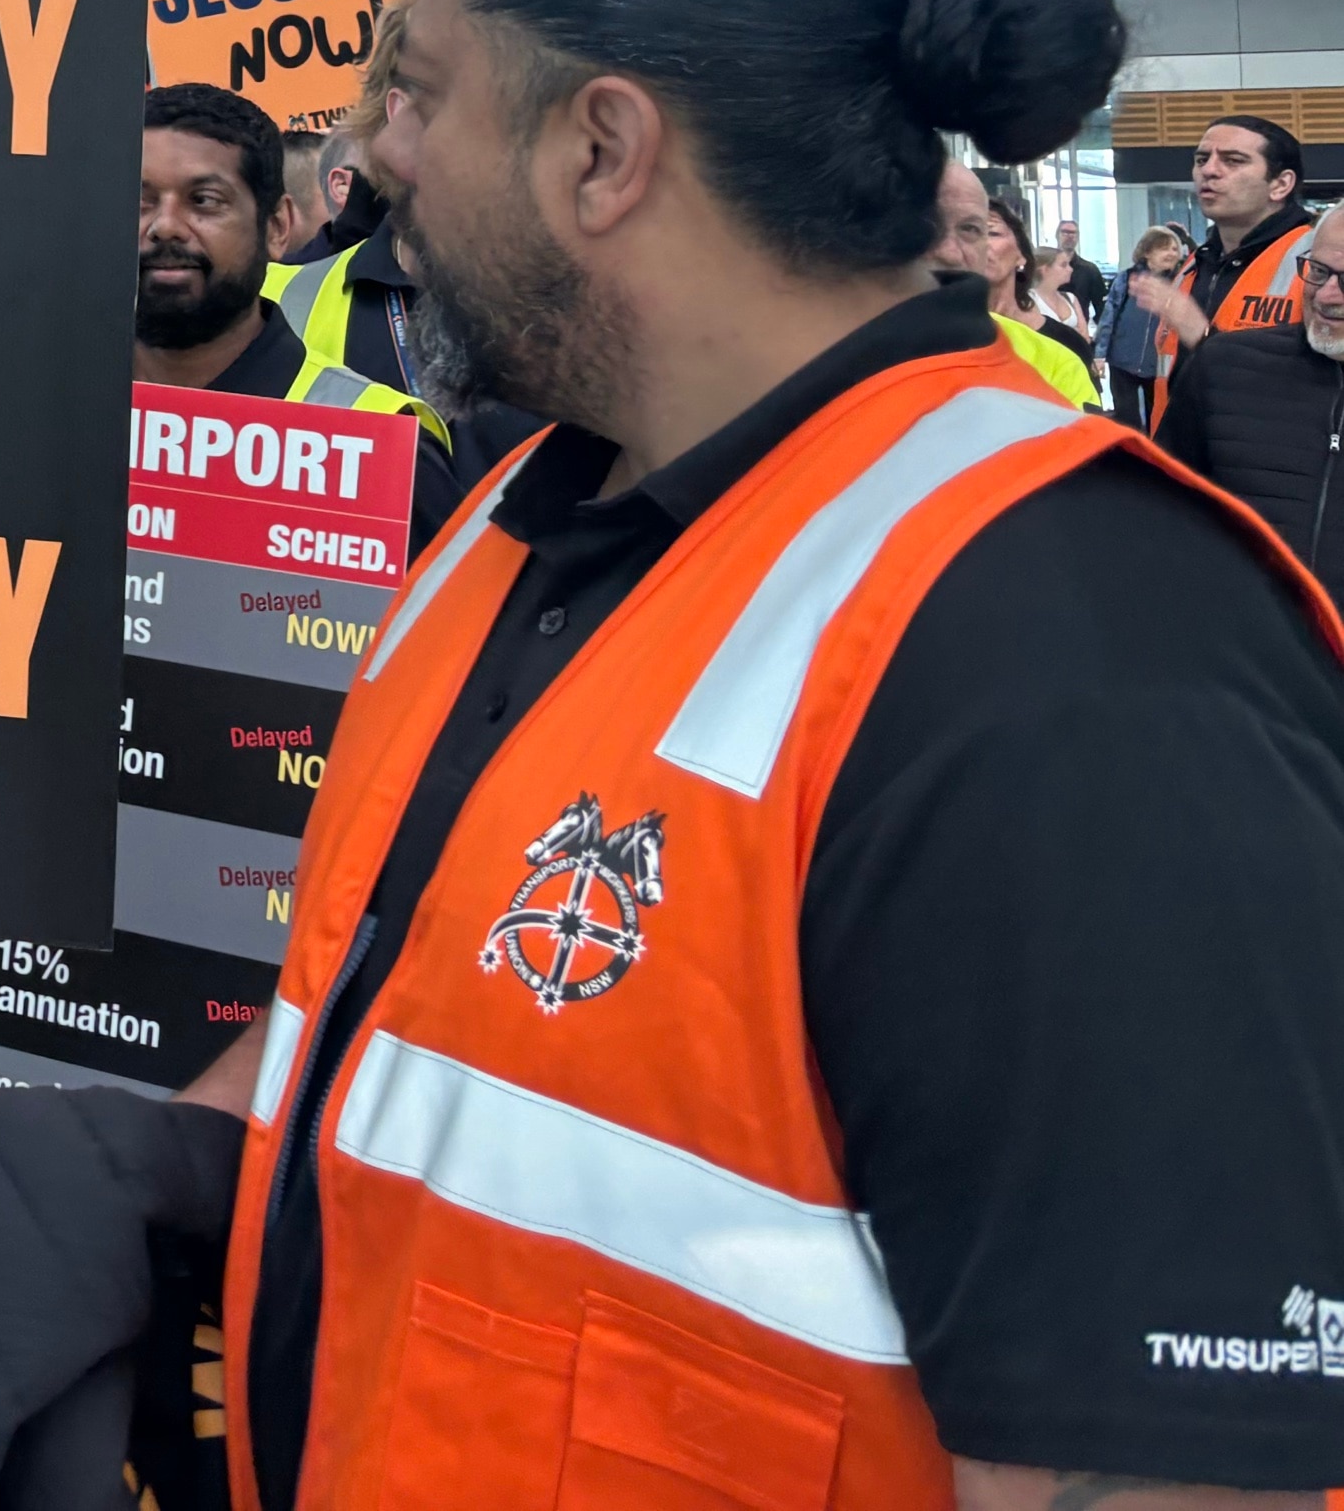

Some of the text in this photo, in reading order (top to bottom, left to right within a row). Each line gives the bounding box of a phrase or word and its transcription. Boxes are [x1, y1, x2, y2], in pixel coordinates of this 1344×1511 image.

[308, 105, 354, 130] TW
[1239, 295, 1293, 325] TWU
[266, 524, 397, 575] SCHED.
[239, 589, 322, 616] Delayed
[230, 725, 313, 751] Delayed
[578, 971, 612, 997] NSW
